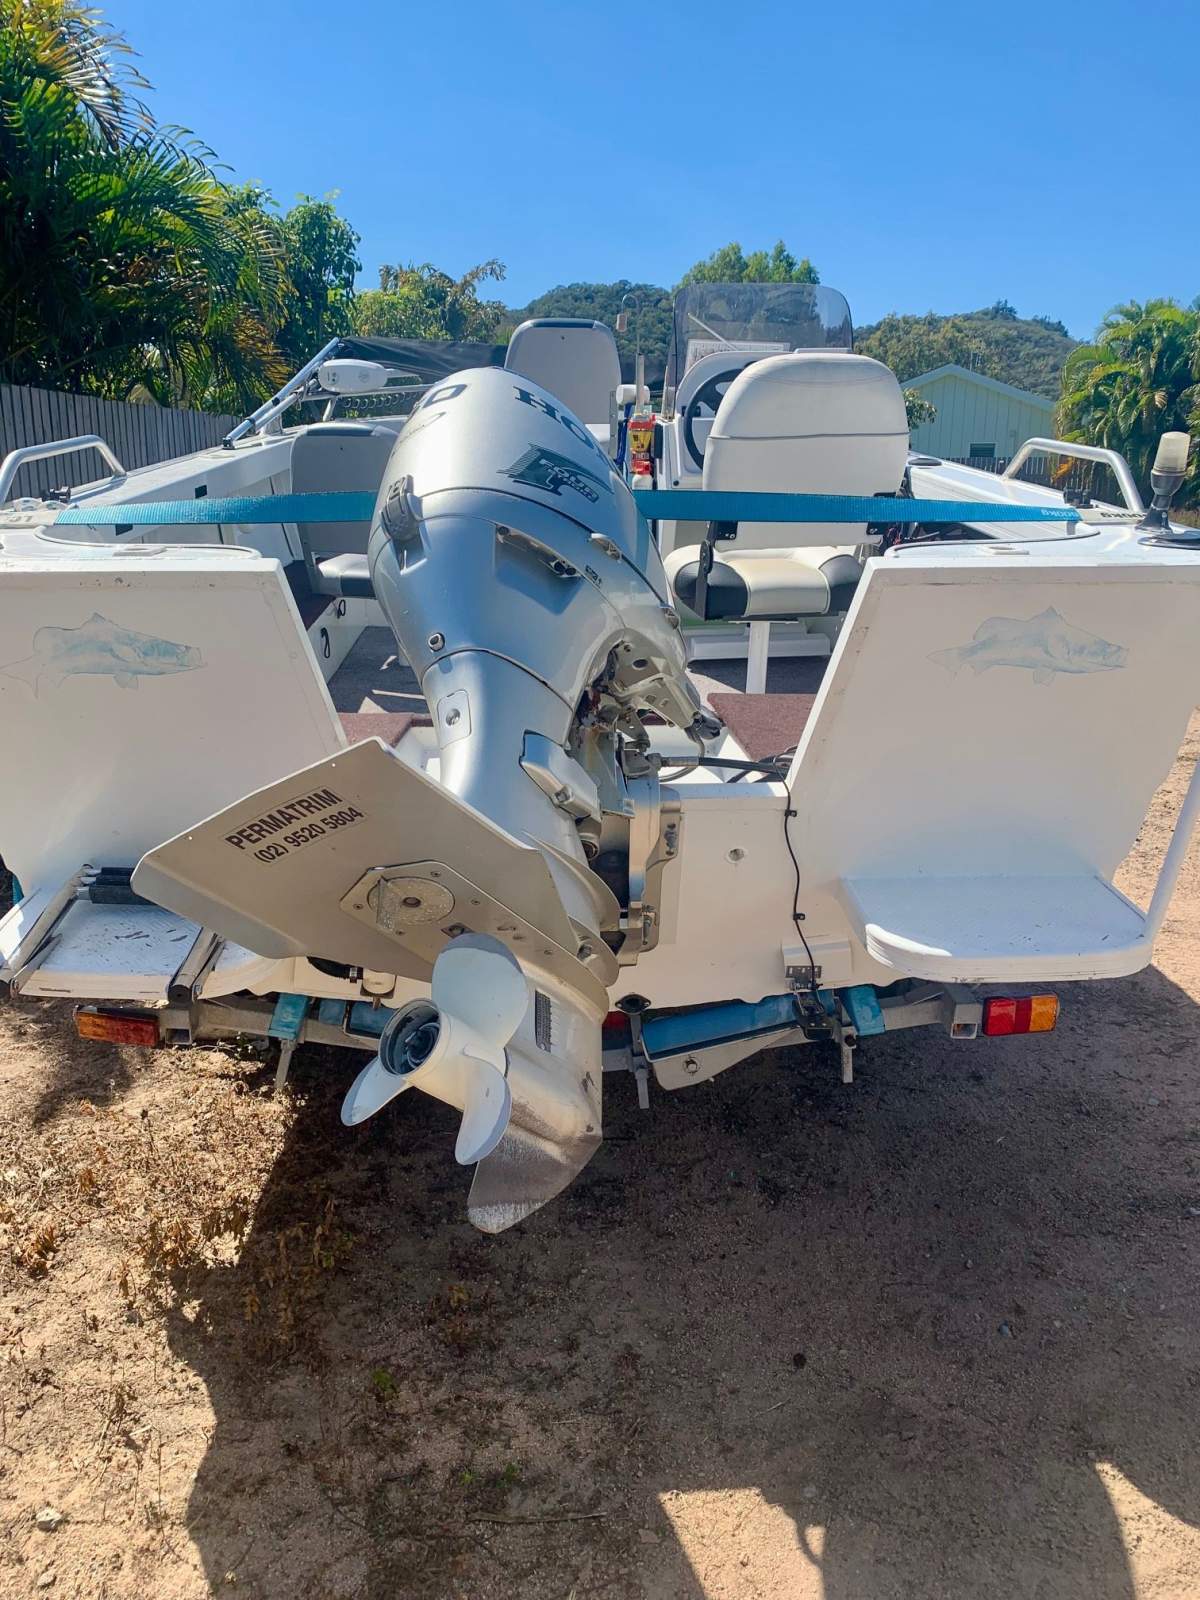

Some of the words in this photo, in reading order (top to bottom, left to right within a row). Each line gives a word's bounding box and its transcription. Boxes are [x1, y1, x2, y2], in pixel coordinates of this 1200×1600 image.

[225, 788, 343, 850] PERMATRIM
[253, 842, 289, 863] (02)
[283, 822, 326, 847] 9520
[319, 807, 364, 830] 5804
